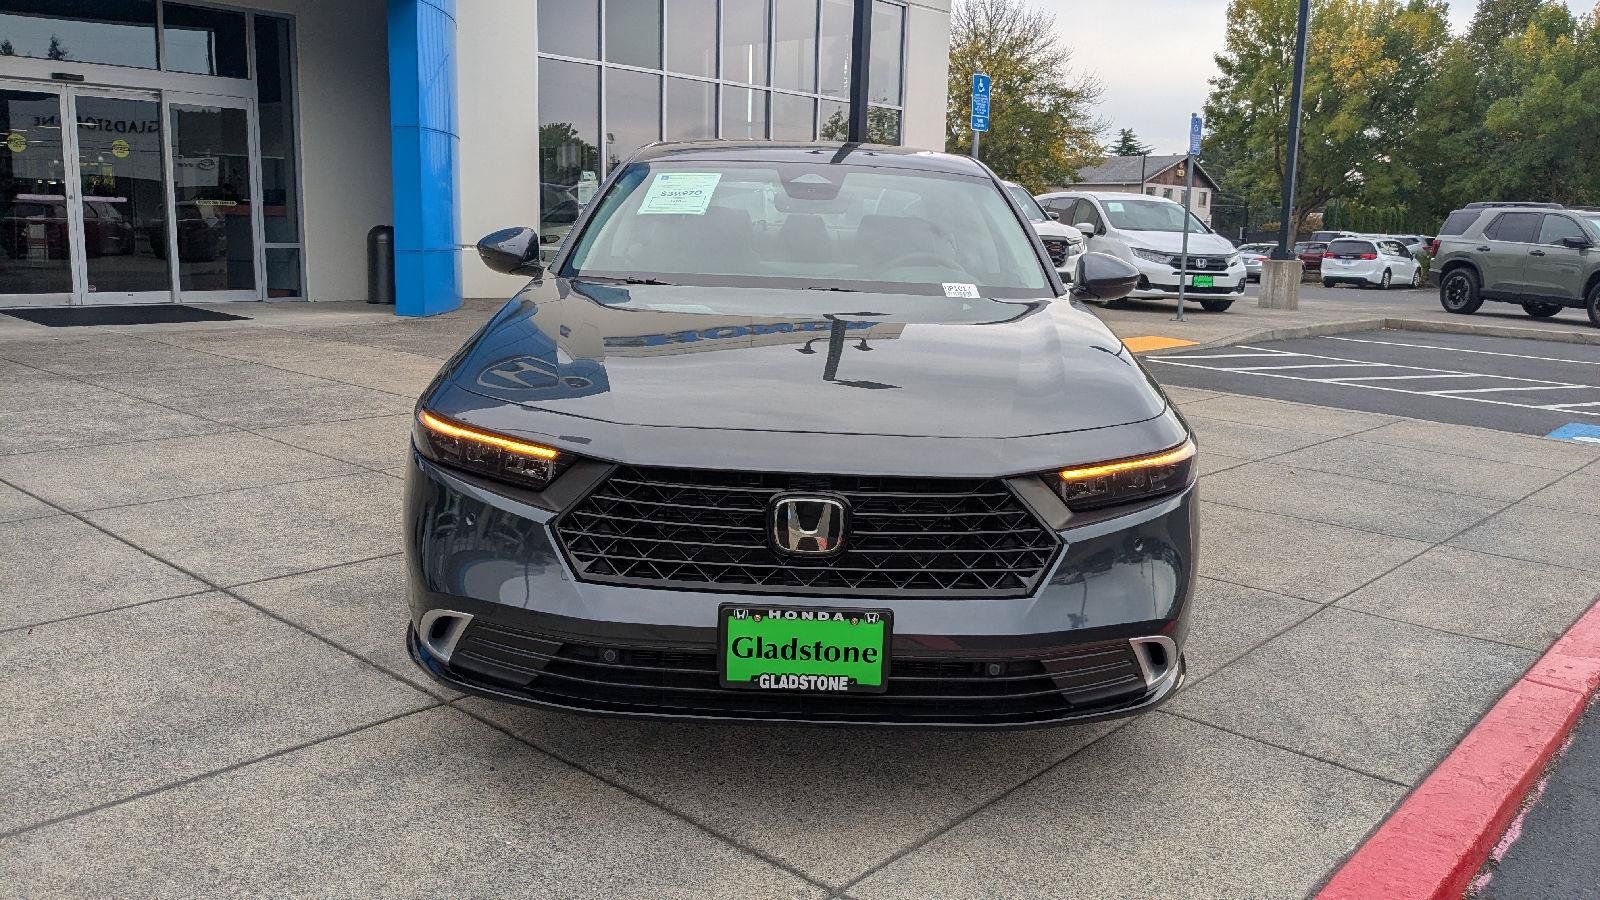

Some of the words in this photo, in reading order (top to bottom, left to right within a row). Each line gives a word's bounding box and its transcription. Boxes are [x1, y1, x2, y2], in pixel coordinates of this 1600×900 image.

[768, 609, 845, 621] HONDA
[731, 635, 878, 664] Gladstone
[759, 673, 849, 691] GLADSTONE
